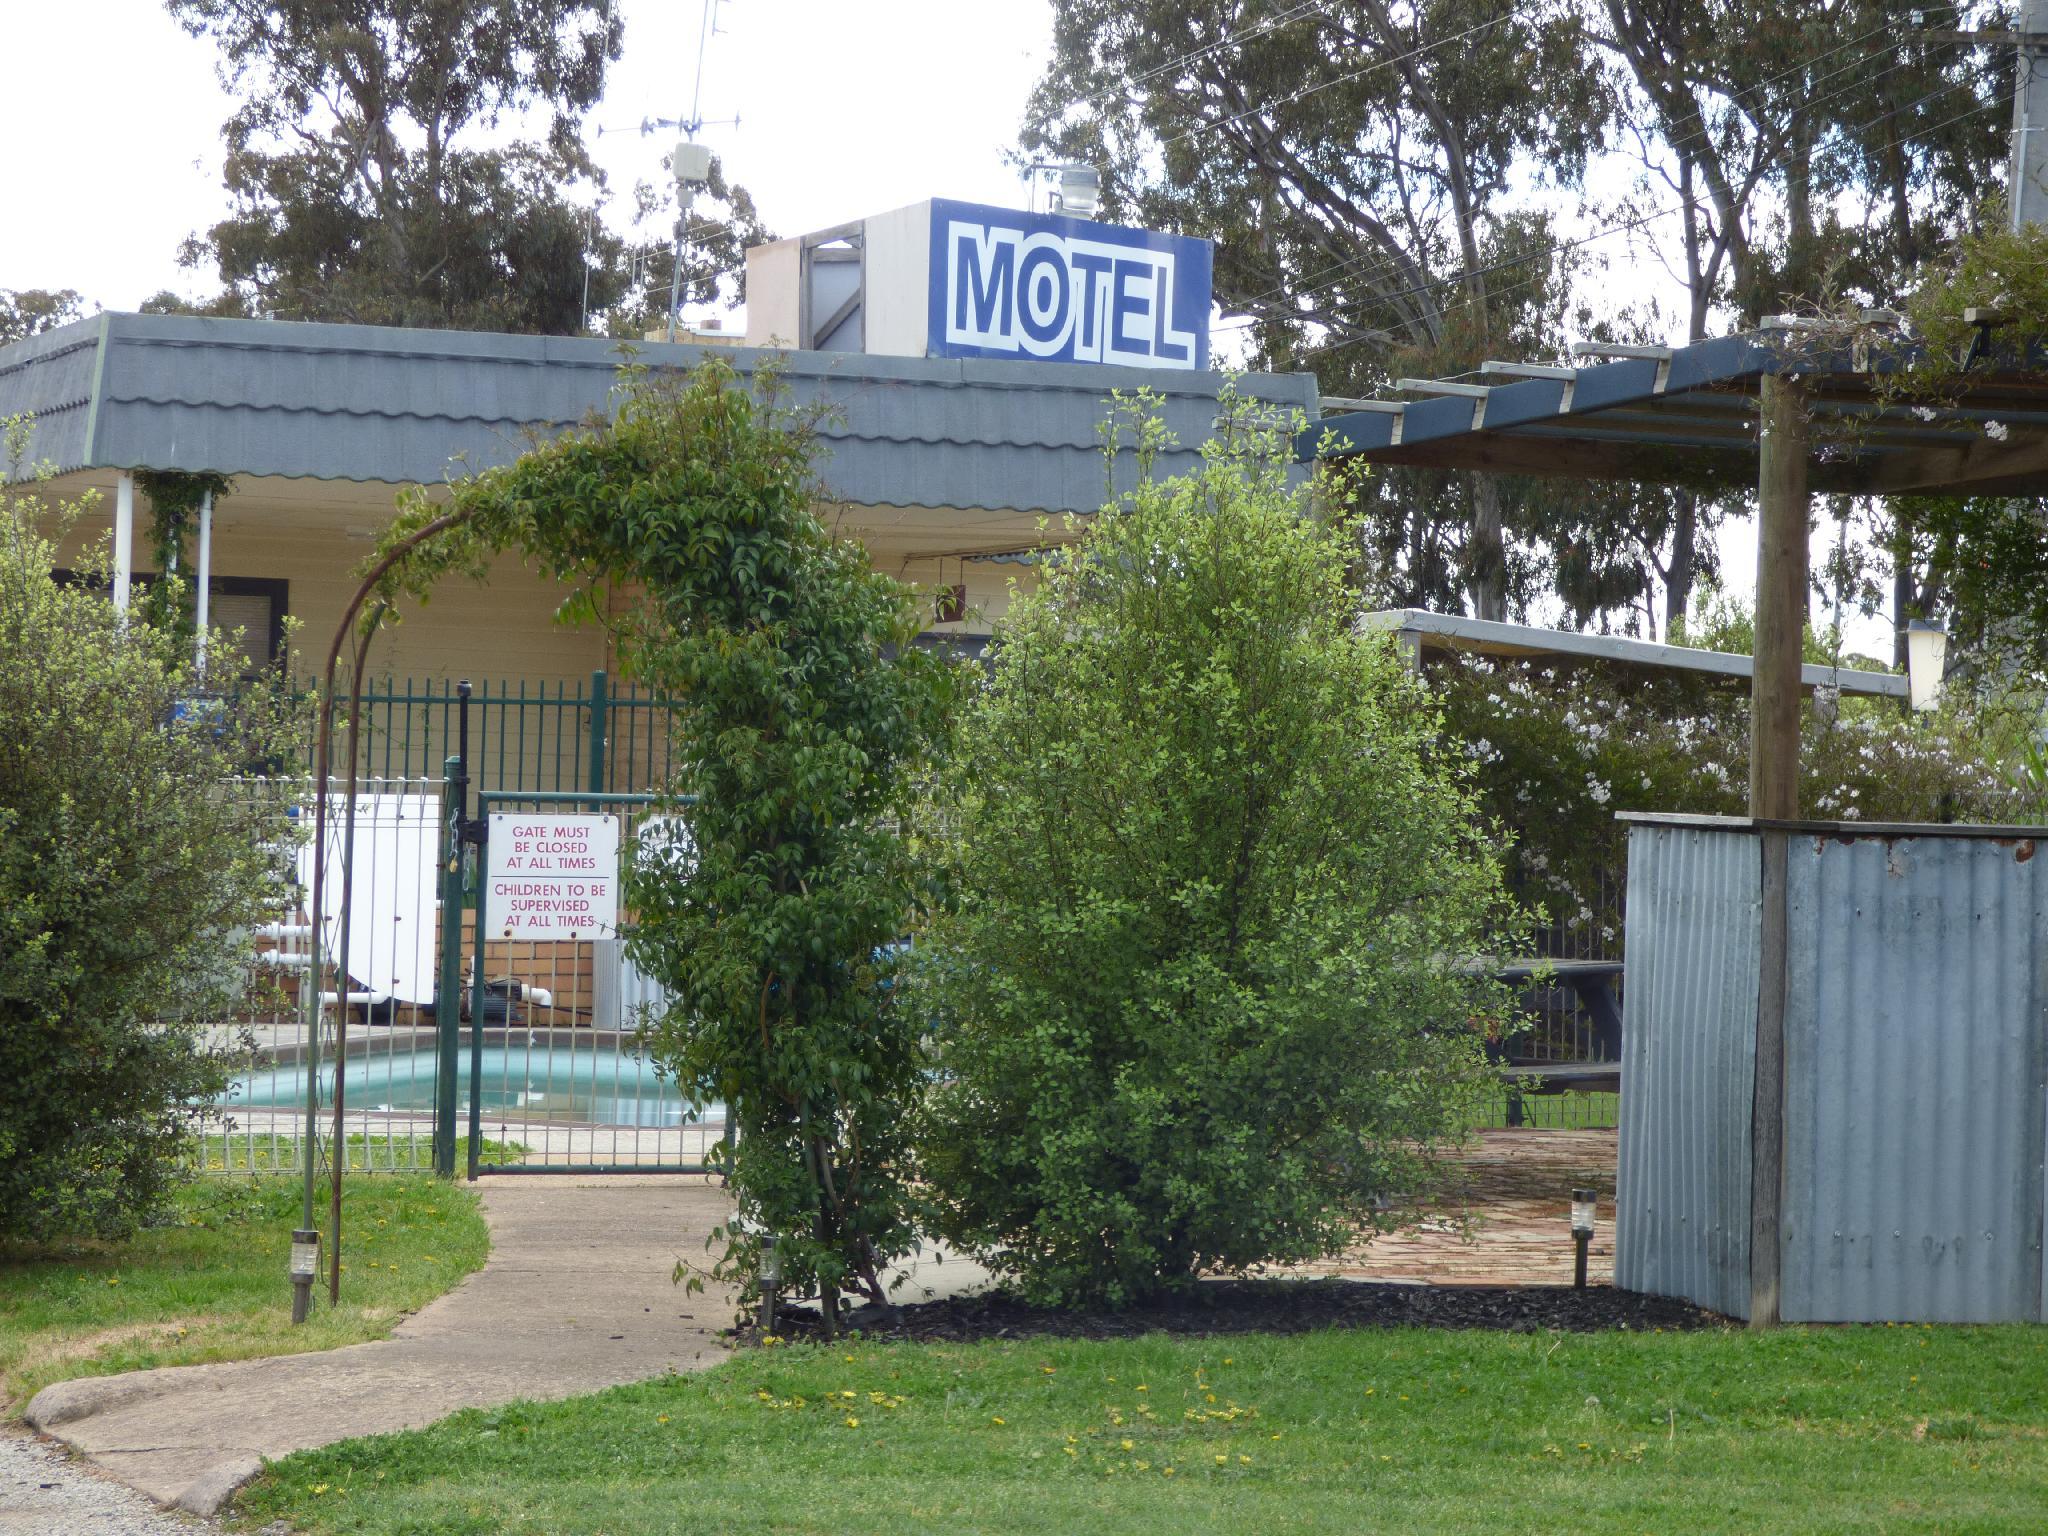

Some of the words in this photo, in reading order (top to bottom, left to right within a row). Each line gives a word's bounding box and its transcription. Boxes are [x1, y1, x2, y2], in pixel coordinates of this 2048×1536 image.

[946, 220, 1196, 371] MOTEL
[513, 826, 546, 837] GATE
[554, 827, 590, 838] MUST
[515, 842, 529, 852] BE
[537, 842, 587, 853] CLOSED
[507, 857, 523, 868] AT
[529, 858, 552, 868] ALL
[558, 858, 595, 868] TIMES
[495, 884, 560, 896] CHILDREN
[568, 885, 584, 896] TO
[591, 885, 605, 896] BE
[511, 900, 589, 911] SUPERVISED
[505, 916, 520, 926] AT
[528, 916, 550, 926] ALL
[558, 916, 594, 926] TIMES
